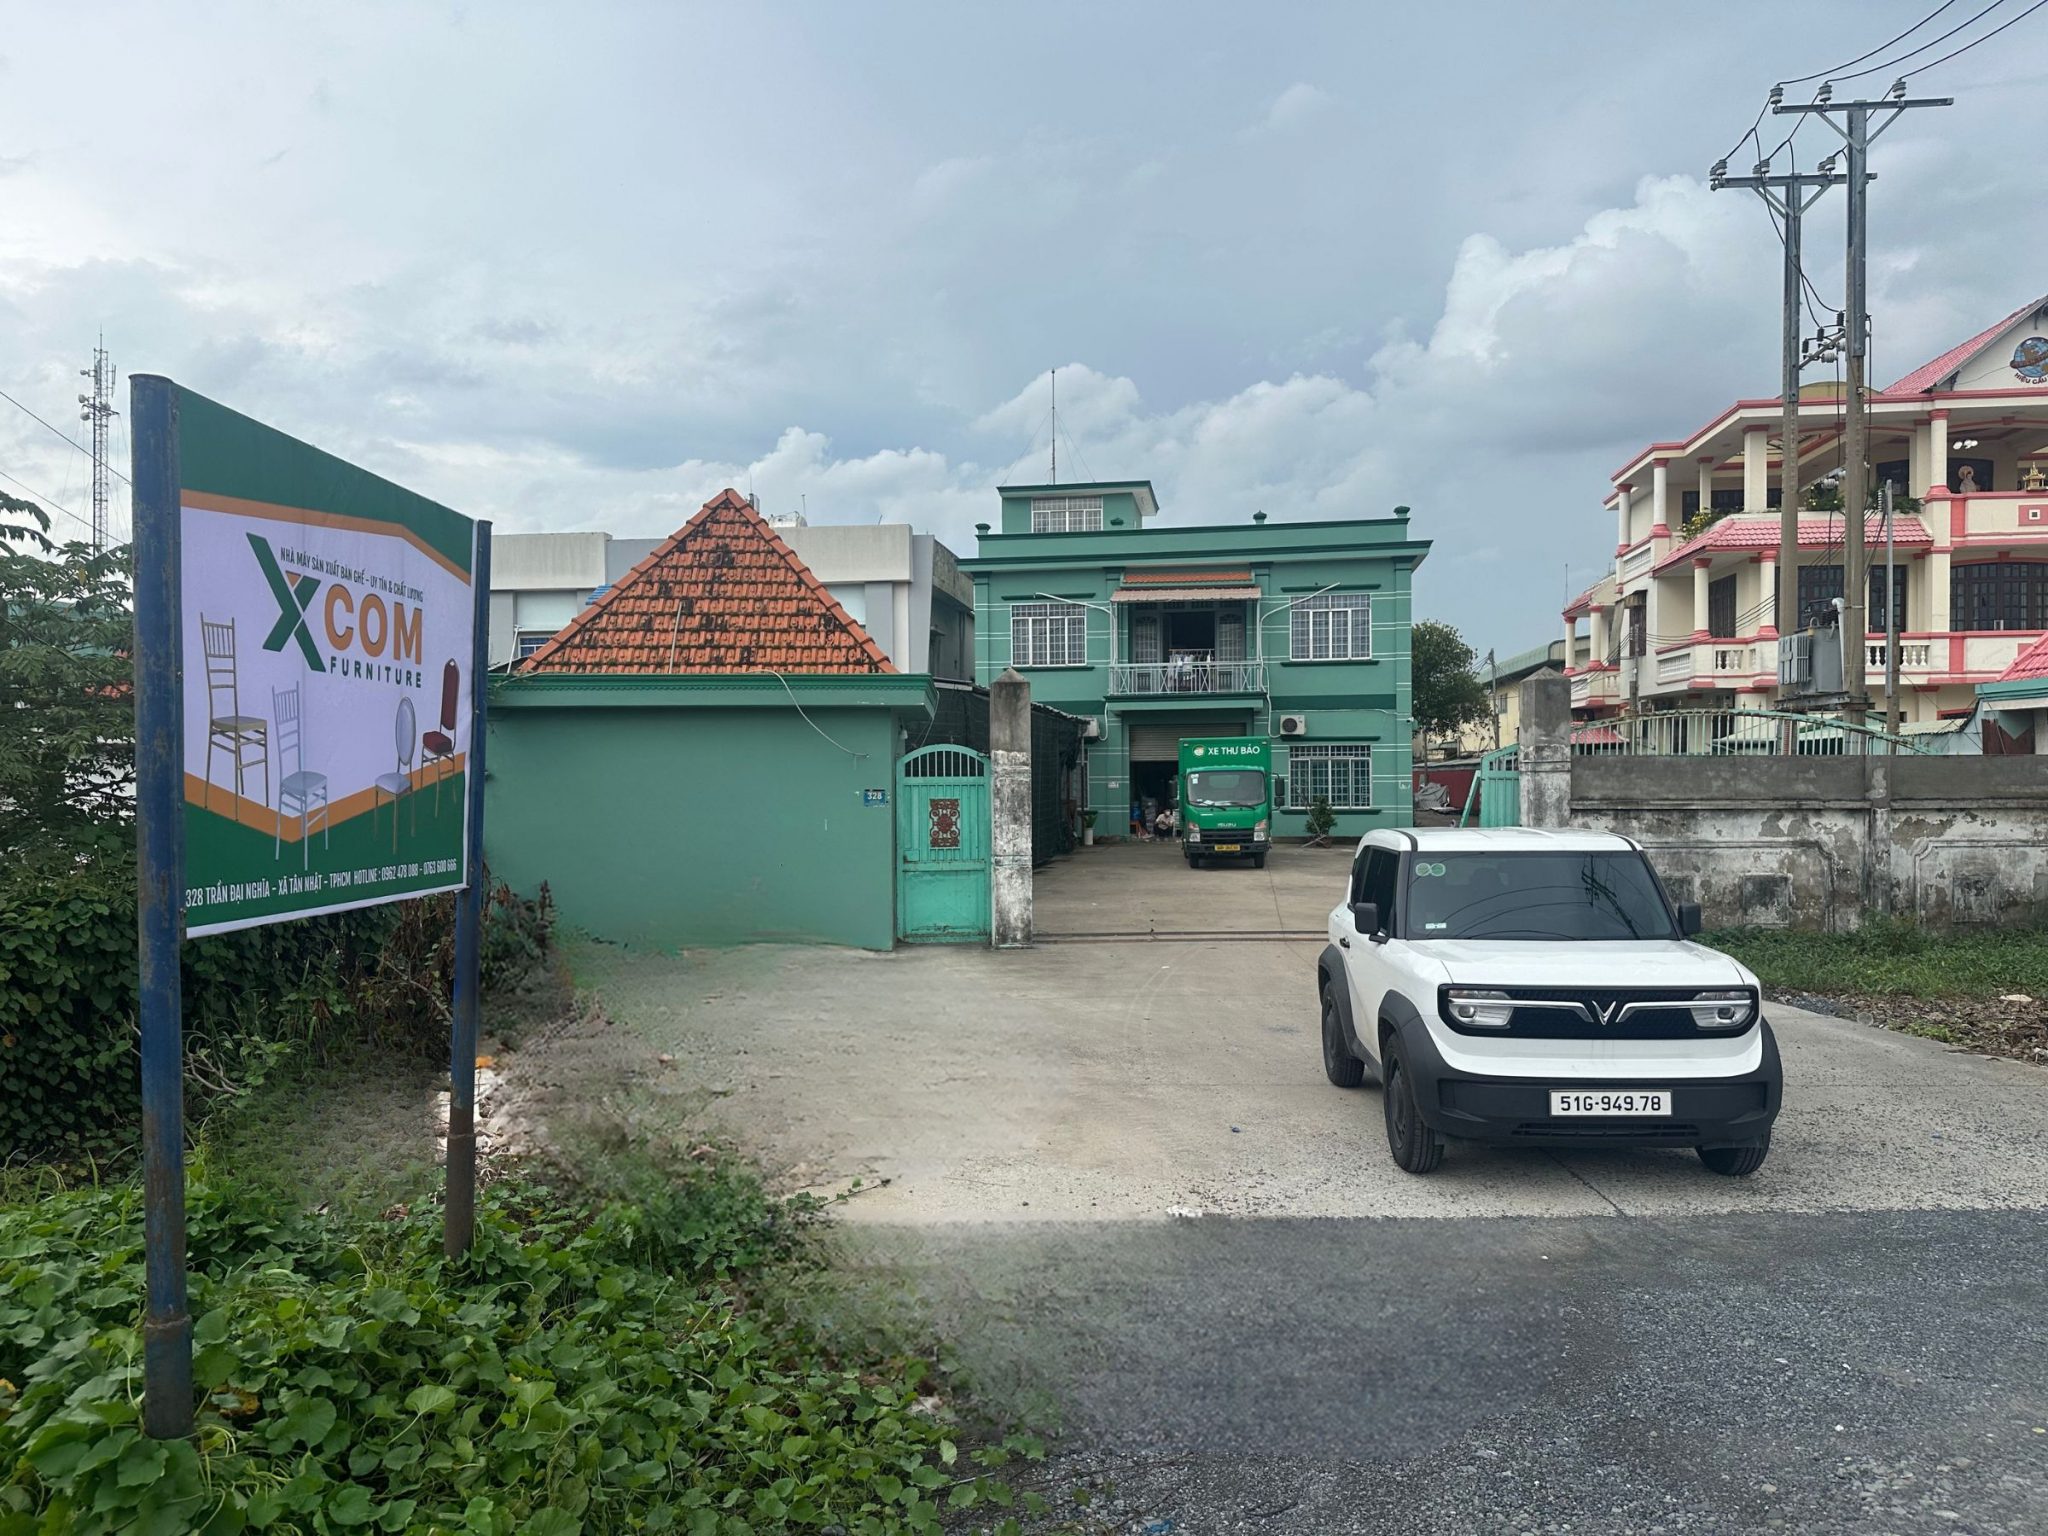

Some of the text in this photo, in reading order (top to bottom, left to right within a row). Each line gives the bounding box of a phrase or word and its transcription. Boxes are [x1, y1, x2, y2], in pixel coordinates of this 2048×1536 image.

[281, 546, 295, 564] NHÀ
[297, 551, 310, 569] MÁY
[330, 656, 422, 689] FURNITURE
[1208, 747, 1219, 755] XE
[1221, 746, 1239, 755] THƯ
[867, 791, 882, 800] 328
[185, 888, 204, 908] 328
[230, 883, 244, 905] ĐẠI
[245, 878, 270, 900] NGHĨA
[278, 875, 288, 896] XÃ
[289, 873, 303, 894] TÂN
[304, 872, 323, 894] NHẬT
[329, 871, 351, 889] TPHCM
[1561, 1096, 1661, 1111] 51G-949.78
